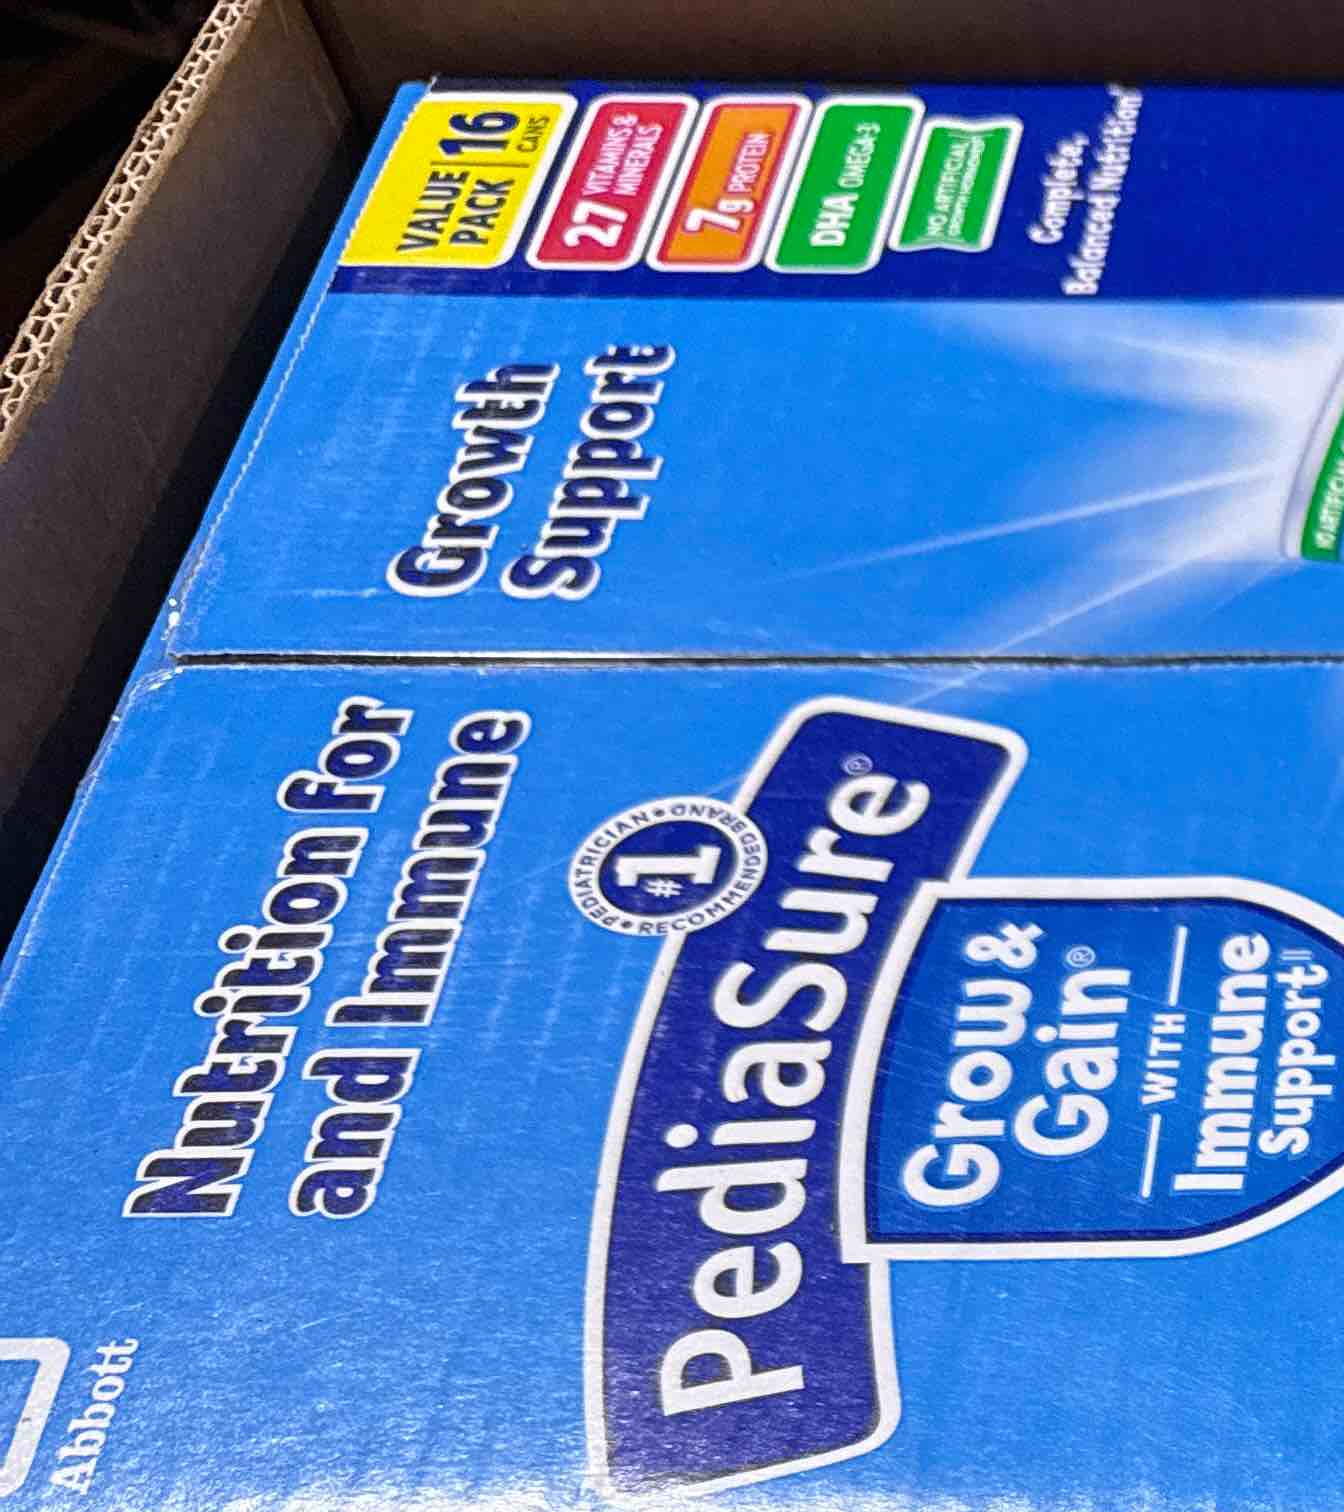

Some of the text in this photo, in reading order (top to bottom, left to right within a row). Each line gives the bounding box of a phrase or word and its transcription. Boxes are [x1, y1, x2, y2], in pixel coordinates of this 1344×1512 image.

[438, 112, 520, 156] 16
[516, 115, 550, 153] CANS
[583, 127, 634, 196] VITAMINS
[612, 123, 663, 196] MINERALS
[685, 132, 773, 233] 7g PROTEIN
[810, 121, 881, 247] DHA OMEGA-3
[1028, 130, 1090, 243] Complete,
[397, 170, 470, 252] VALUE
[449, 178, 515, 245] PACK
[563, 201, 629, 248] 27
[1061, 191, 1122, 295] Balanced
[387, 360, 559, 596] Growth
[502, 342, 676, 598] Support
[571, 809, 651, 928] PEDIATRICIAN
[616, 845, 721, 899] #1
[639, 803, 763, 935] RECOMMENDED BRAND
[125, 694, 414, 1218] Nutrition for
[289, 711, 532, 1219] and Immune
[903, 921, 1046, 1208] Grow &
[1142, 1012, 1186, 1106] WITH
[1172, 932, 1271, 1191] Immune
[50, 1338, 139, 1495] Abbott
